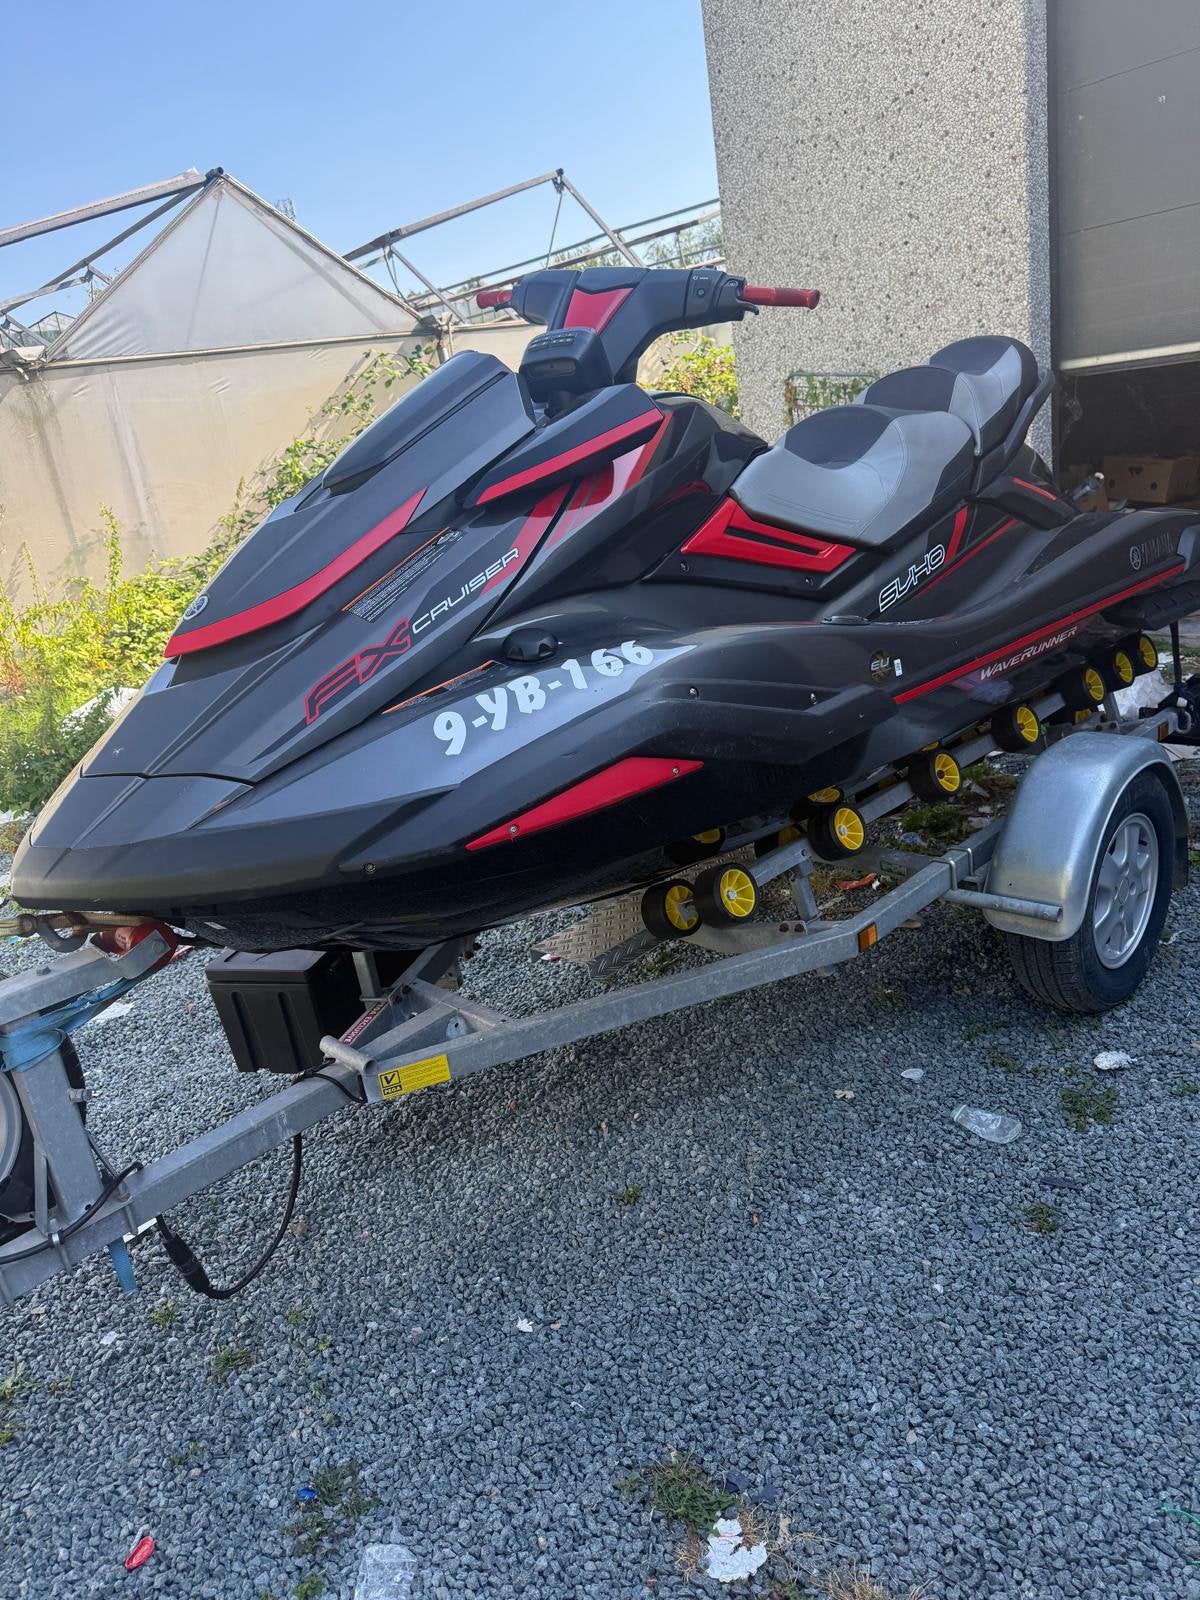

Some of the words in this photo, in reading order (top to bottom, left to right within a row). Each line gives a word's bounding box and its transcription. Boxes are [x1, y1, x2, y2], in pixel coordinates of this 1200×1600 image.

[879, 544, 945, 613] SVHO
[304, 617, 412, 725] FX
[412, 547, 519, 634] CRUISER
[870, 656, 890, 671] EU
[433, 640, 654, 756] 9-YB-166
